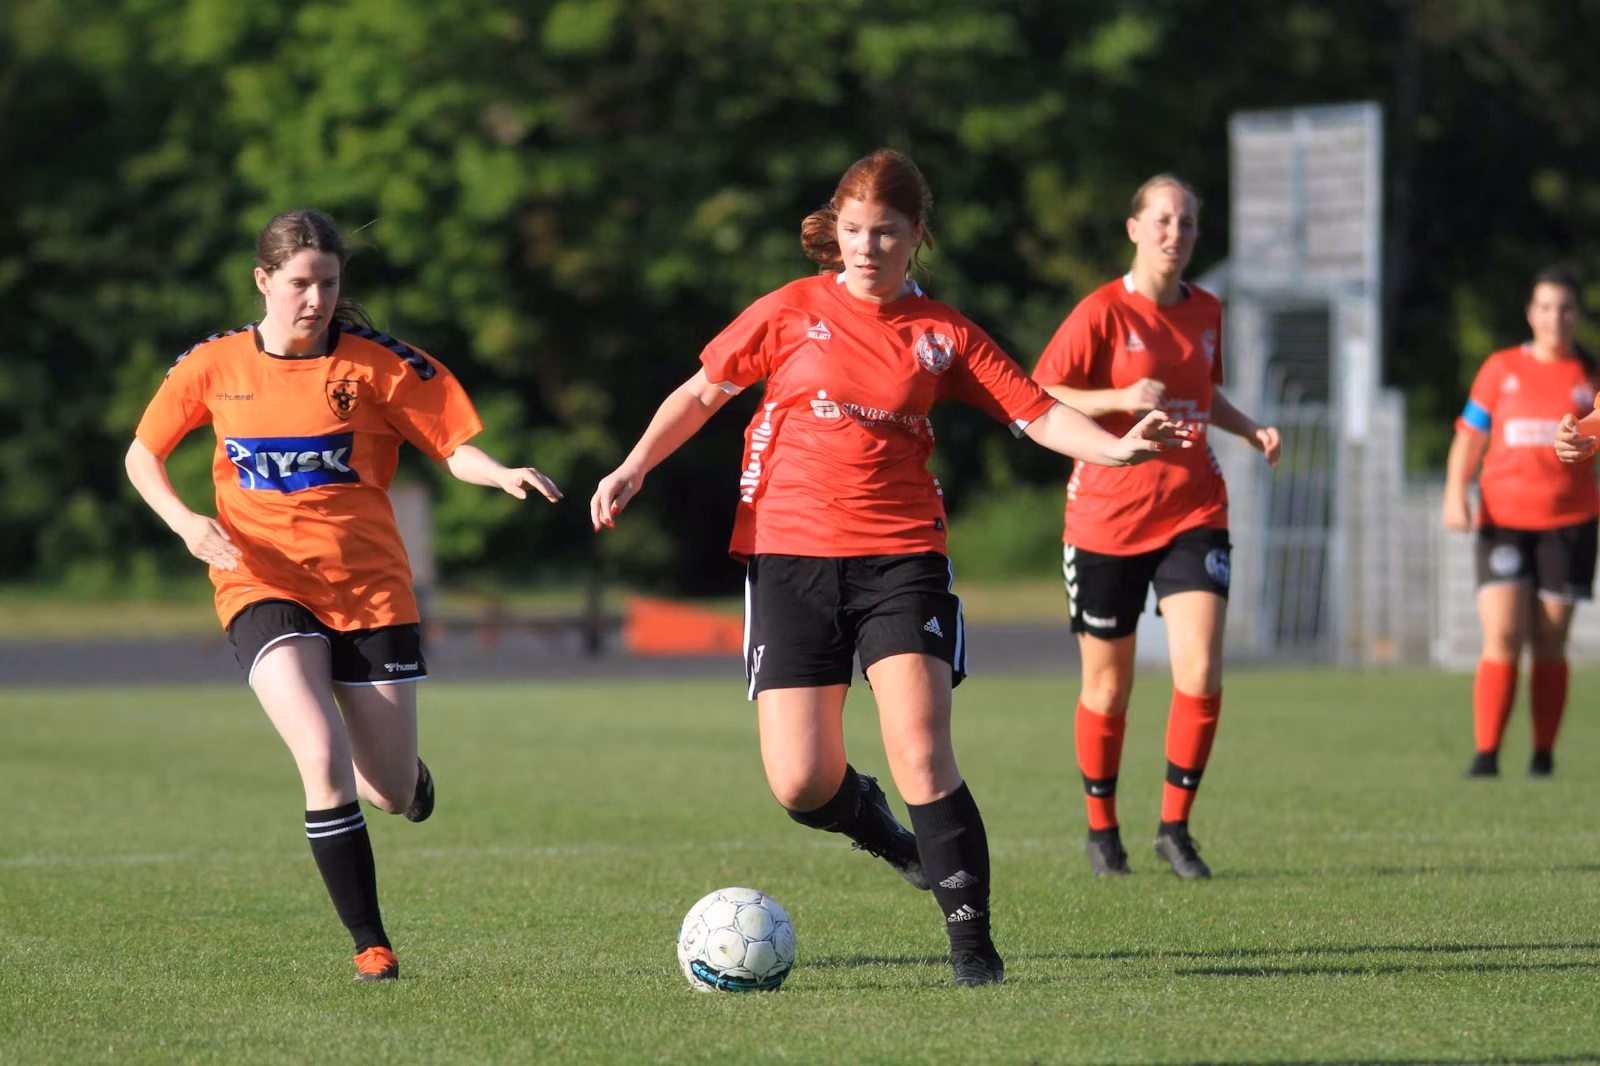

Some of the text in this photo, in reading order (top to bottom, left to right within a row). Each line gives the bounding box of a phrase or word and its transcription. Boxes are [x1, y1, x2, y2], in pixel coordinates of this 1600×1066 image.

[807, 331, 832, 340] SELECT
[224, 392, 254, 401] hummel
[923, 624, 944, 638] adidas
[947, 911, 984, 923] adidas
